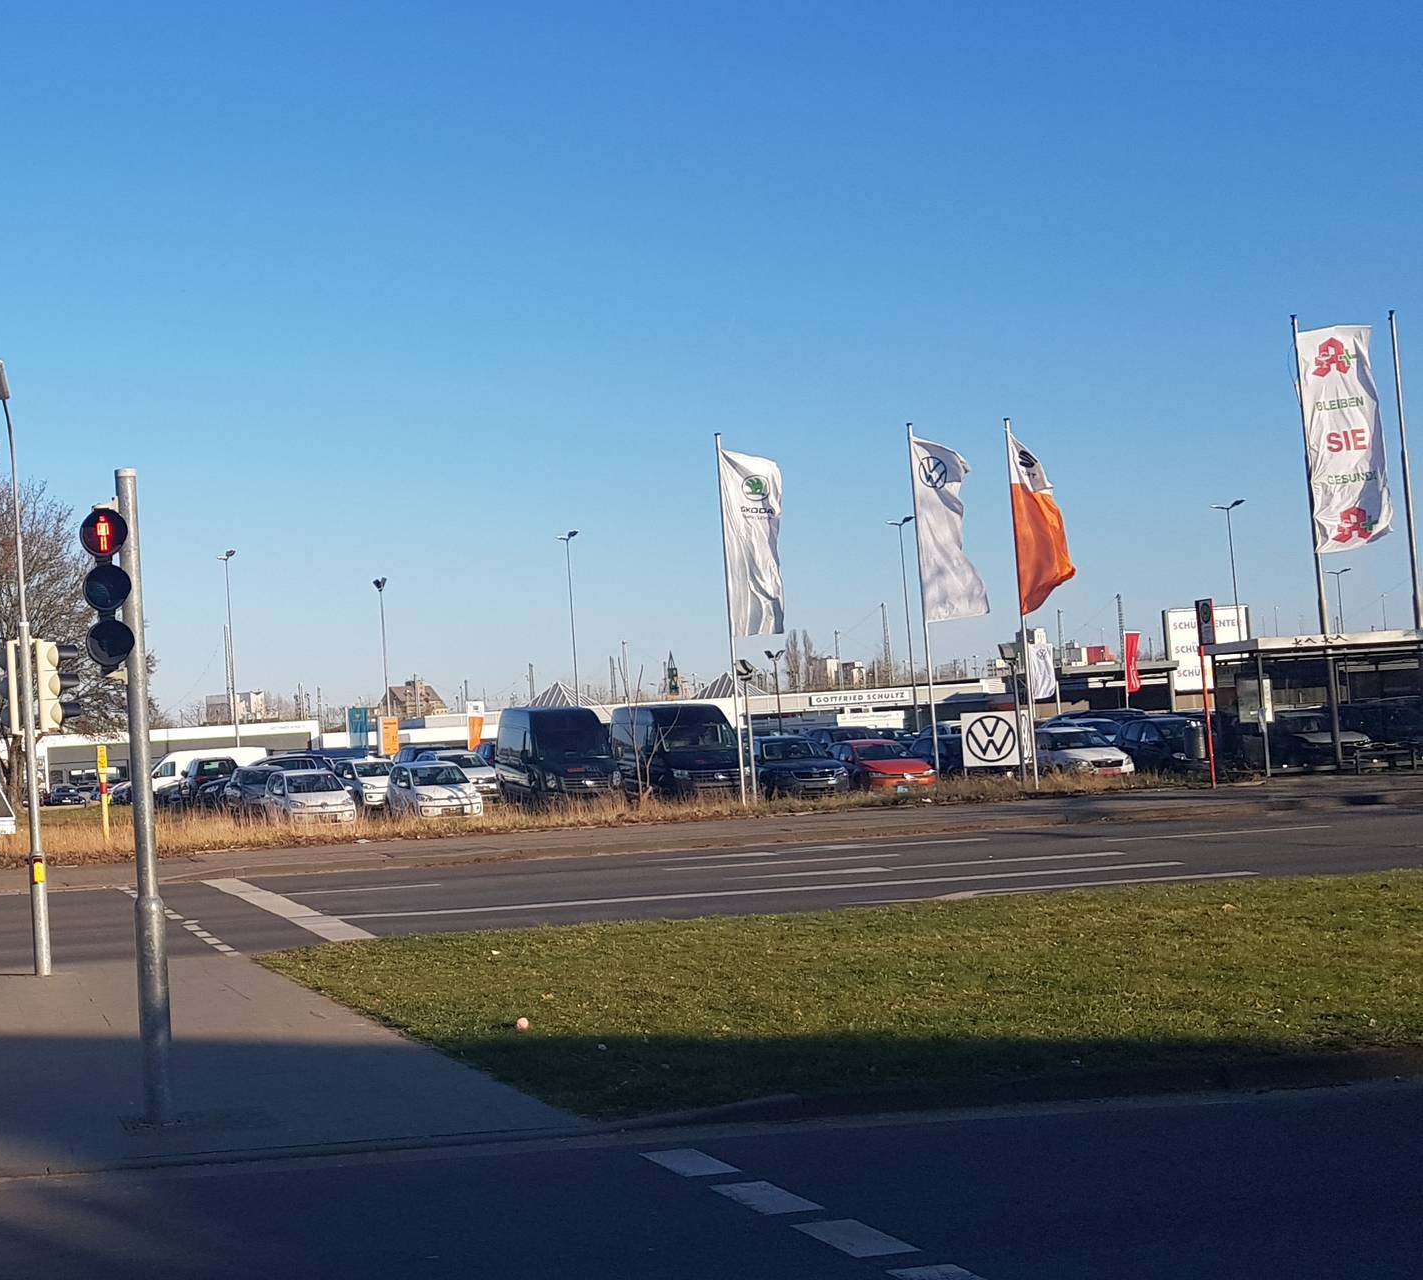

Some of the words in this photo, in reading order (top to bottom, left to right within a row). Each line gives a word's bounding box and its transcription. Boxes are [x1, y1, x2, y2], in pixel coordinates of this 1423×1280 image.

[1316, 396, 1364, 411] BLEIBEN
[1327, 428, 1367, 453] SIE
[815, 694, 864, 703] GOTTFRIED
[866, 691, 905, 701] SCHULTZ
